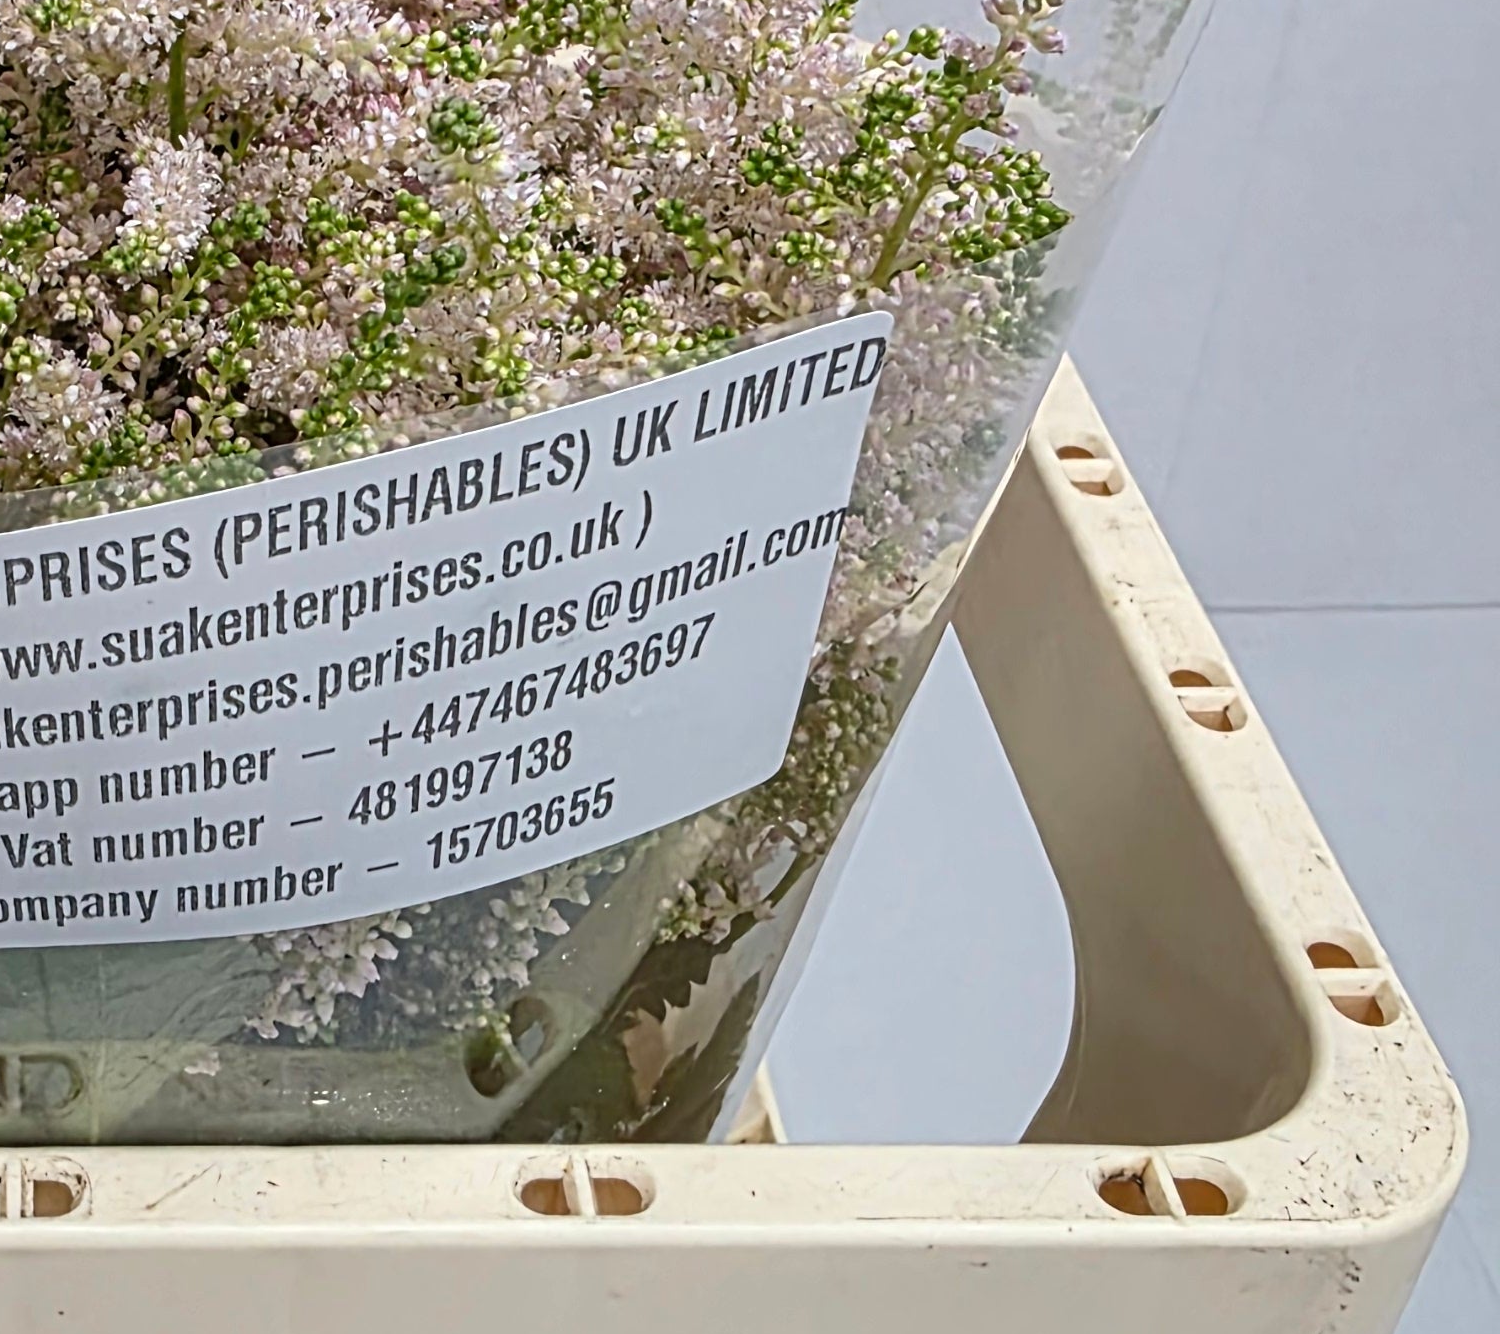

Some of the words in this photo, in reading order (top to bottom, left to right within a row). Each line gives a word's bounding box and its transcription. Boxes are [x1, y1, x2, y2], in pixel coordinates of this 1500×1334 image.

[214, 429, 591, 579] (PERISHABLES)
[612, 401, 680, 467] UK
[693, 337, 886, 443] LIMITED
[99, 750, 276, 805] number
[369, 612, 716, 757] +447467483697
[0, 830, 72, 869] Vat
[93, 818, 264, 864] number
[348, 730, 573, 828] 481997138
[177, 860, 342, 913] number
[425, 777, 616, 870] 15703655
